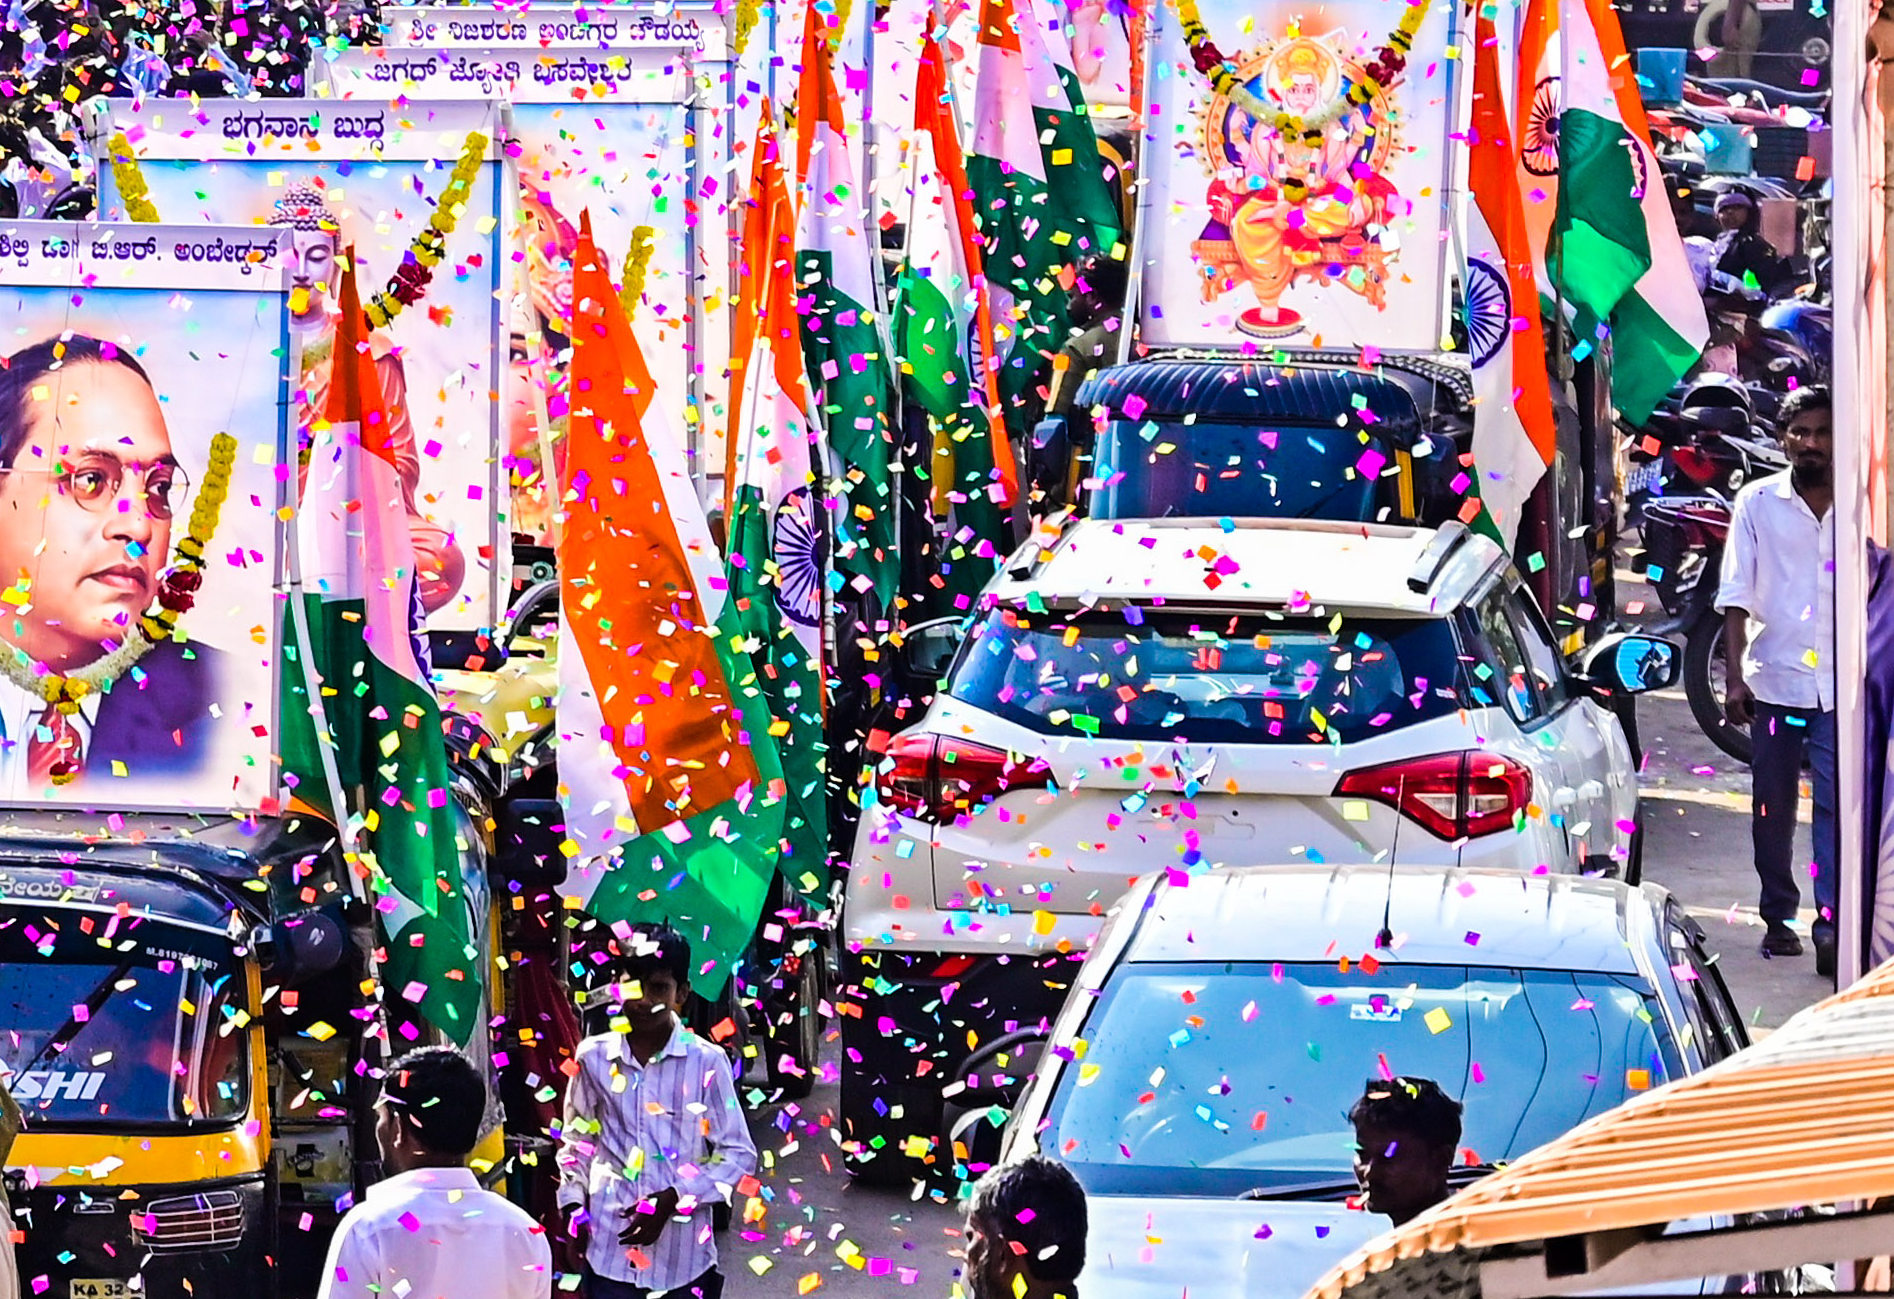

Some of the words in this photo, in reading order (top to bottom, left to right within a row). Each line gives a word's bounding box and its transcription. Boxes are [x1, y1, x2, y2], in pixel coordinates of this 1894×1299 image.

[374, 57, 436, 81] ಜಗದ್
[10, 1070, 106, 1101] SHI
[73, 1283, 99, 1296] KA
[104, 1283, 124, 1296] 32
